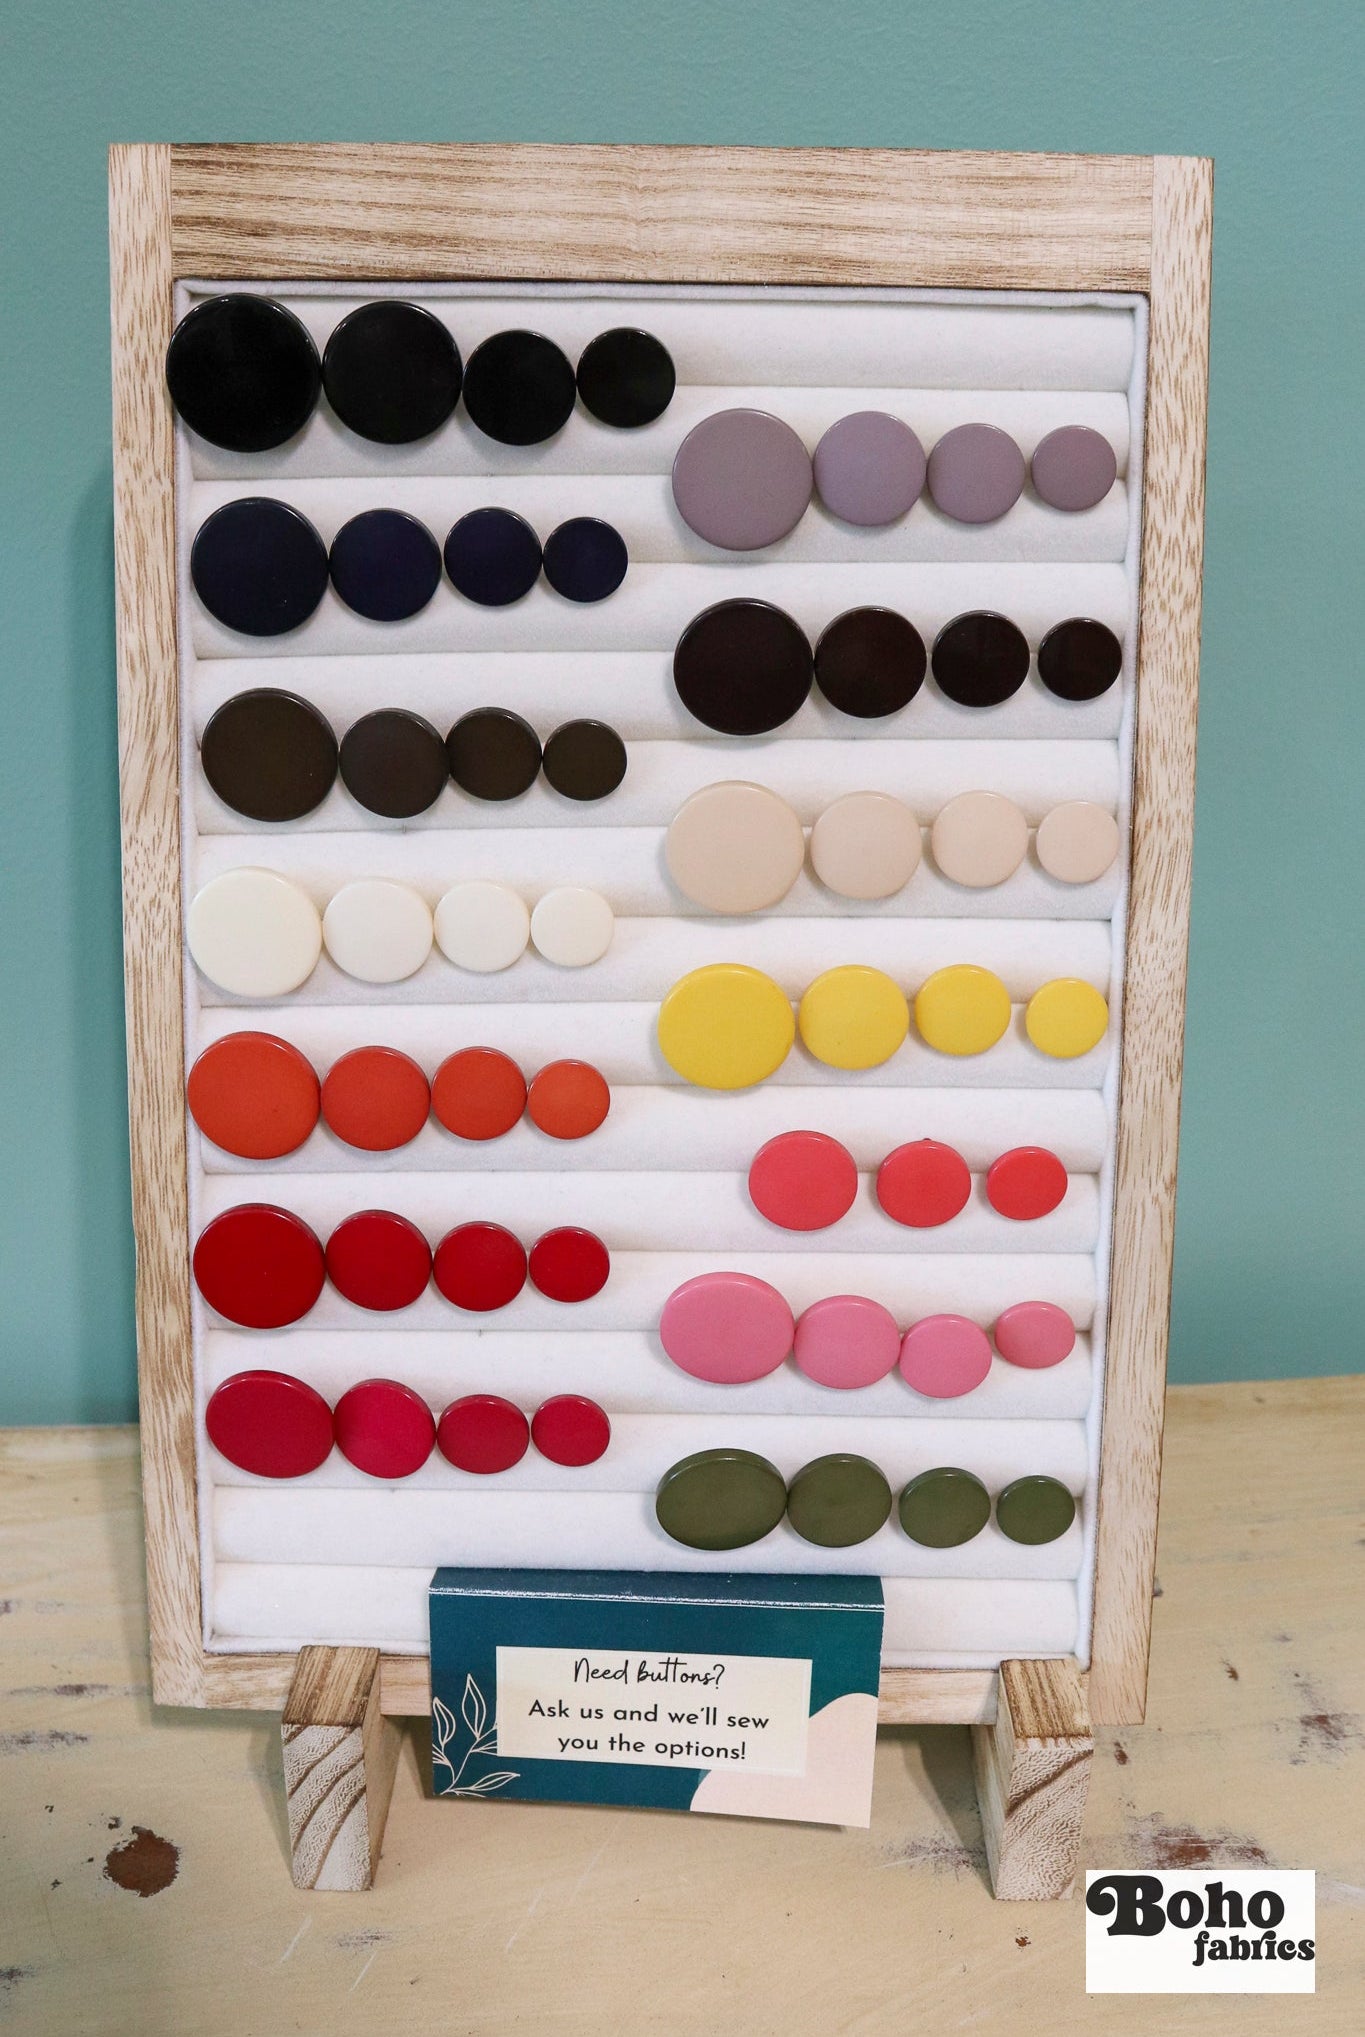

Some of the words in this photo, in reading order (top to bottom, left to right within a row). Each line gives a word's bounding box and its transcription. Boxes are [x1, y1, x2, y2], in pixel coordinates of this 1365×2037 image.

[574, 1657, 628, 1685] Need
[637, 1656, 725, 1690] buttons?
[528, 1699, 570, 1718] Ask
[580, 1706, 604, 1720] us
[613, 1703, 658, 1723] and
[668, 1706, 717, 1726] we'll
[727, 1715, 769, 1729] sew
[557, 1736, 598, 1753] you
[608, 1733, 645, 1753] the
[655, 1740, 746, 1760] options!
